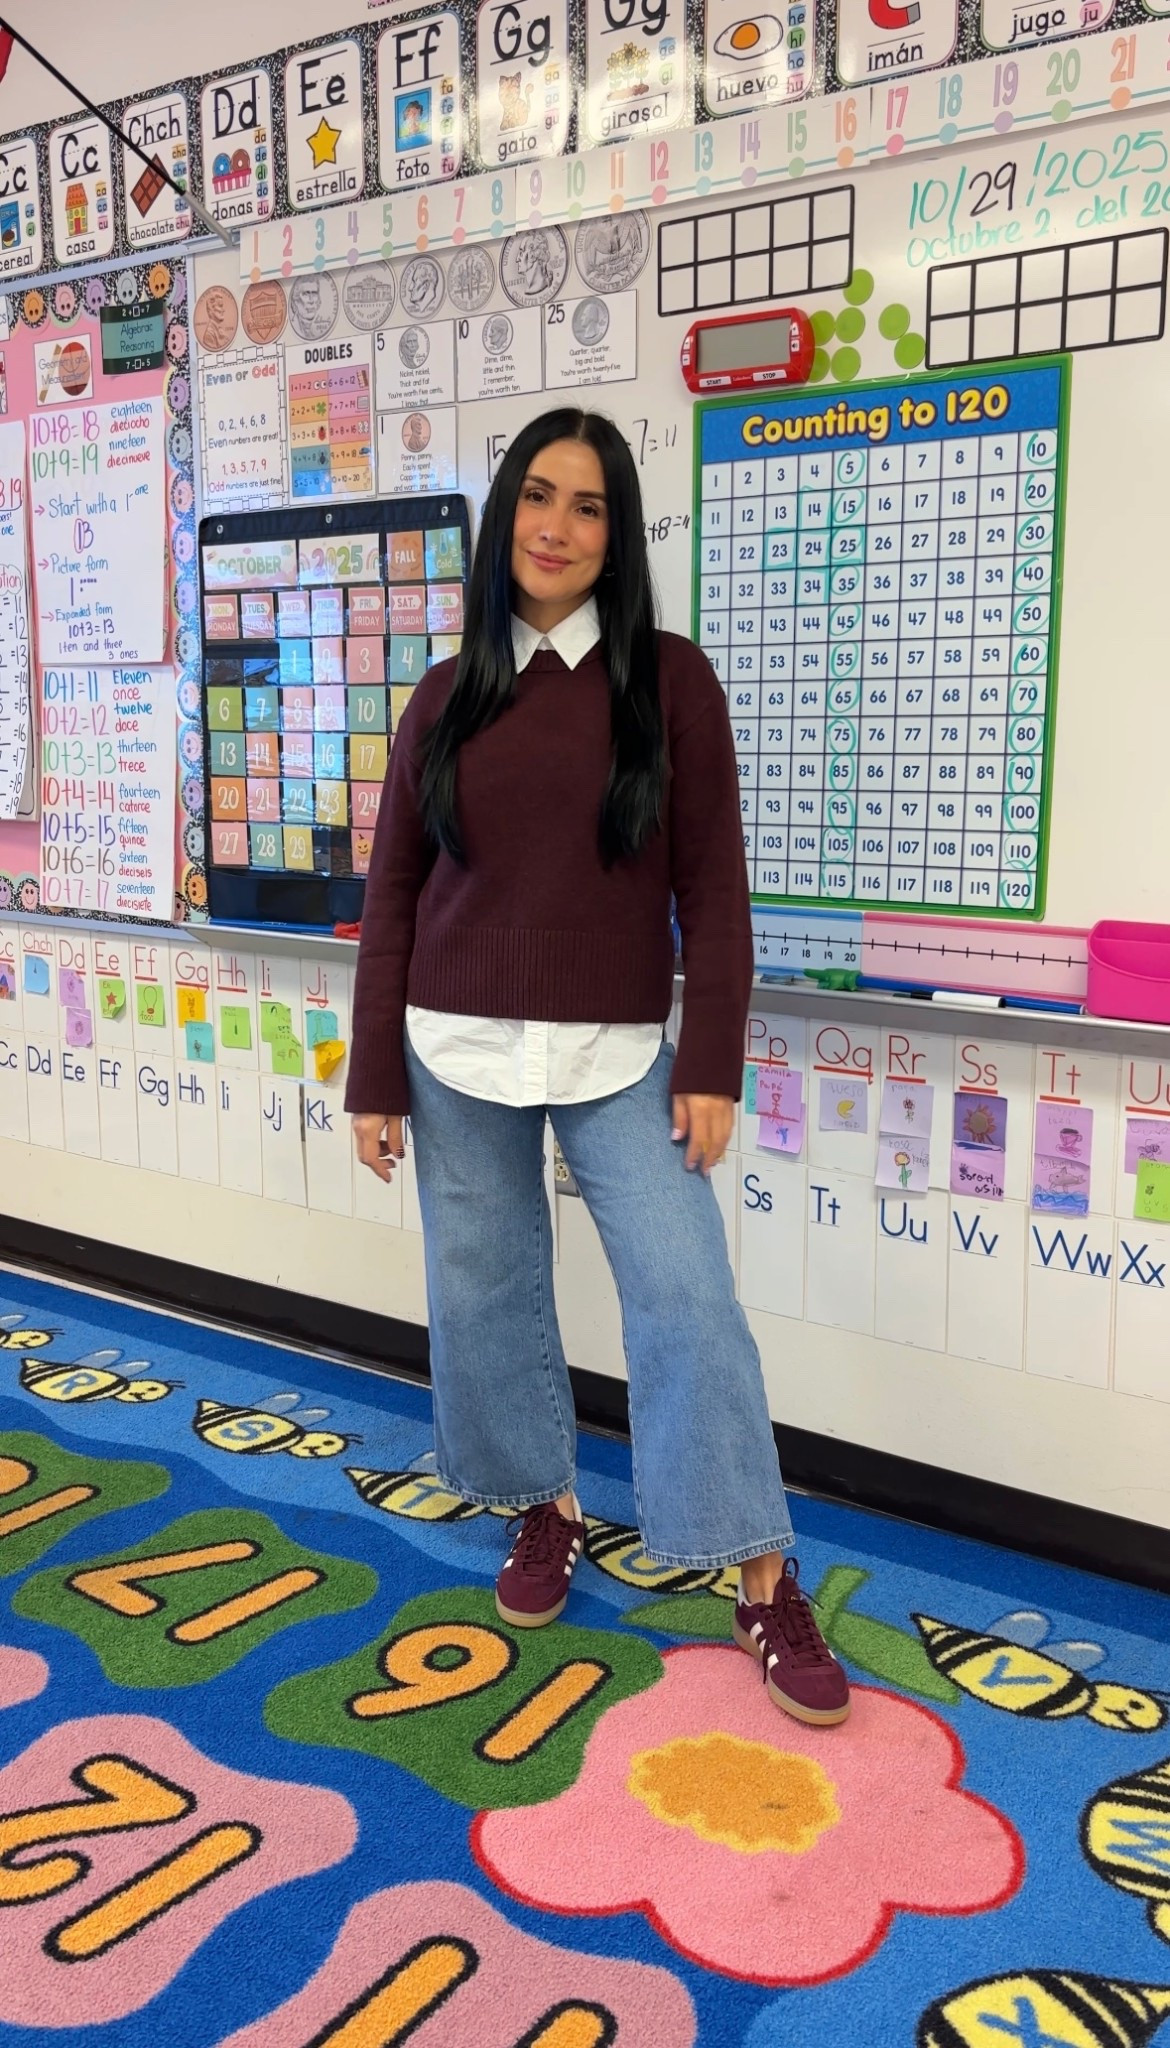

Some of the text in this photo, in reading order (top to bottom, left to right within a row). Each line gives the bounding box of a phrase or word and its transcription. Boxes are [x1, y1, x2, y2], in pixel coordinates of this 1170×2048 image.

[788, 10, 805, 25] he
[1009, 10, 1066, 43] jugo
[1081, 8, 1098, 27] ju
[494, 6, 551, 67] Gg
[790, 33, 803, 48] hi
[395, 25, 441, 88] Ff
[868, 43, 923, 71] imán
[300, 59, 345, 114] Ee
[717, 74, 778, 102] huevo
[214, 78, 259, 136] Dd
[129, 106, 181, 145] Chch
[602, 102, 669, 134] girasol
[255, 131, 266, 144] da
[283, 35, 1136, 256] 2 3 5 6 7 8 9 10 11 12 13 14 15 16 17 18 19 20 21
[61, 134, 98, 178] Cc
[498, 134, 537, 161] gato
[396, 160, 430, 178] foto
[296, 175, 356, 202] estrella
[212, 202, 252, 221] donas
[258, 202, 269, 215] du
[1077, 196, 1129, 228] del
[130, 221, 174, 241] chocolate
[66, 239, 95, 255] casa
[548, 304, 565, 324] 25
[121, 323, 152, 339] Algebraic
[459, 319, 469, 339] 10
[120, 340, 154, 352] Reasoning
[377, 333, 385, 351] 5
[305, 344, 353, 364] DOUBLES
[206, 365, 275, 386] Even or Odd
[111, 402, 152, 419] eighteen
[742, 386, 1008, 445] Counting to 120
[111, 418, 149, 433] dieciocho
[109, 434, 145, 450] nineteen
[208, 438, 227, 449] Even
[228, 435, 251, 445] numbers
[107, 451, 150, 468] diecinueve
[209, 481, 224, 492] Odd
[259, 479, 269, 489] just
[50, 492, 108, 518] Start with
[51, 553, 108, 573] Picture form
[218, 545, 363, 576] OCTOBER 2025
[395, 550, 416, 564] FALL
[56, 602, 112, 622] Expanded form
[248, 604, 267, 614] TUES.
[398, 598, 415, 608] SAT.
[354, 616, 379, 626] FRIDAY
[392, 616, 423, 626] SATURDAY
[104, 638, 122, 649] three
[360, 647, 413, 673] 3 4
[113, 670, 152, 685] Eleven
[113, 689, 141, 700] once
[114, 703, 152, 715] twelve
[220, 698, 375, 723] 6 10
[115, 718, 139, 733] doce
[118, 740, 157, 753] thirteen
[221, 742, 375, 769] 13 17
[119, 759, 146, 773] trece
[119, 783, 160, 800] fourteen
[218, 787, 239, 809] 20
[119, 802, 150, 813] catorce
[118, 817, 148, 834] fifteen
[120, 835, 146, 851] quince
[220, 832, 275, 857] 27 28
[762, 836, 993, 857] 103 104 105 106 107 108 109
[119, 852, 147, 864] sixteen
[119, 865, 152, 877] dieciseis
[117, 883, 155, 895] seventeen
[117, 898, 152, 911] diecisiete
[748, 1019, 1081, 1095] Pp Qq Rr Ss Tt
[28, 1045, 332, 1131] Dd Ee Ff Gg Kk
[744, 1175, 1166, 1286] Ss Tt Uu Vv Ww Xx
